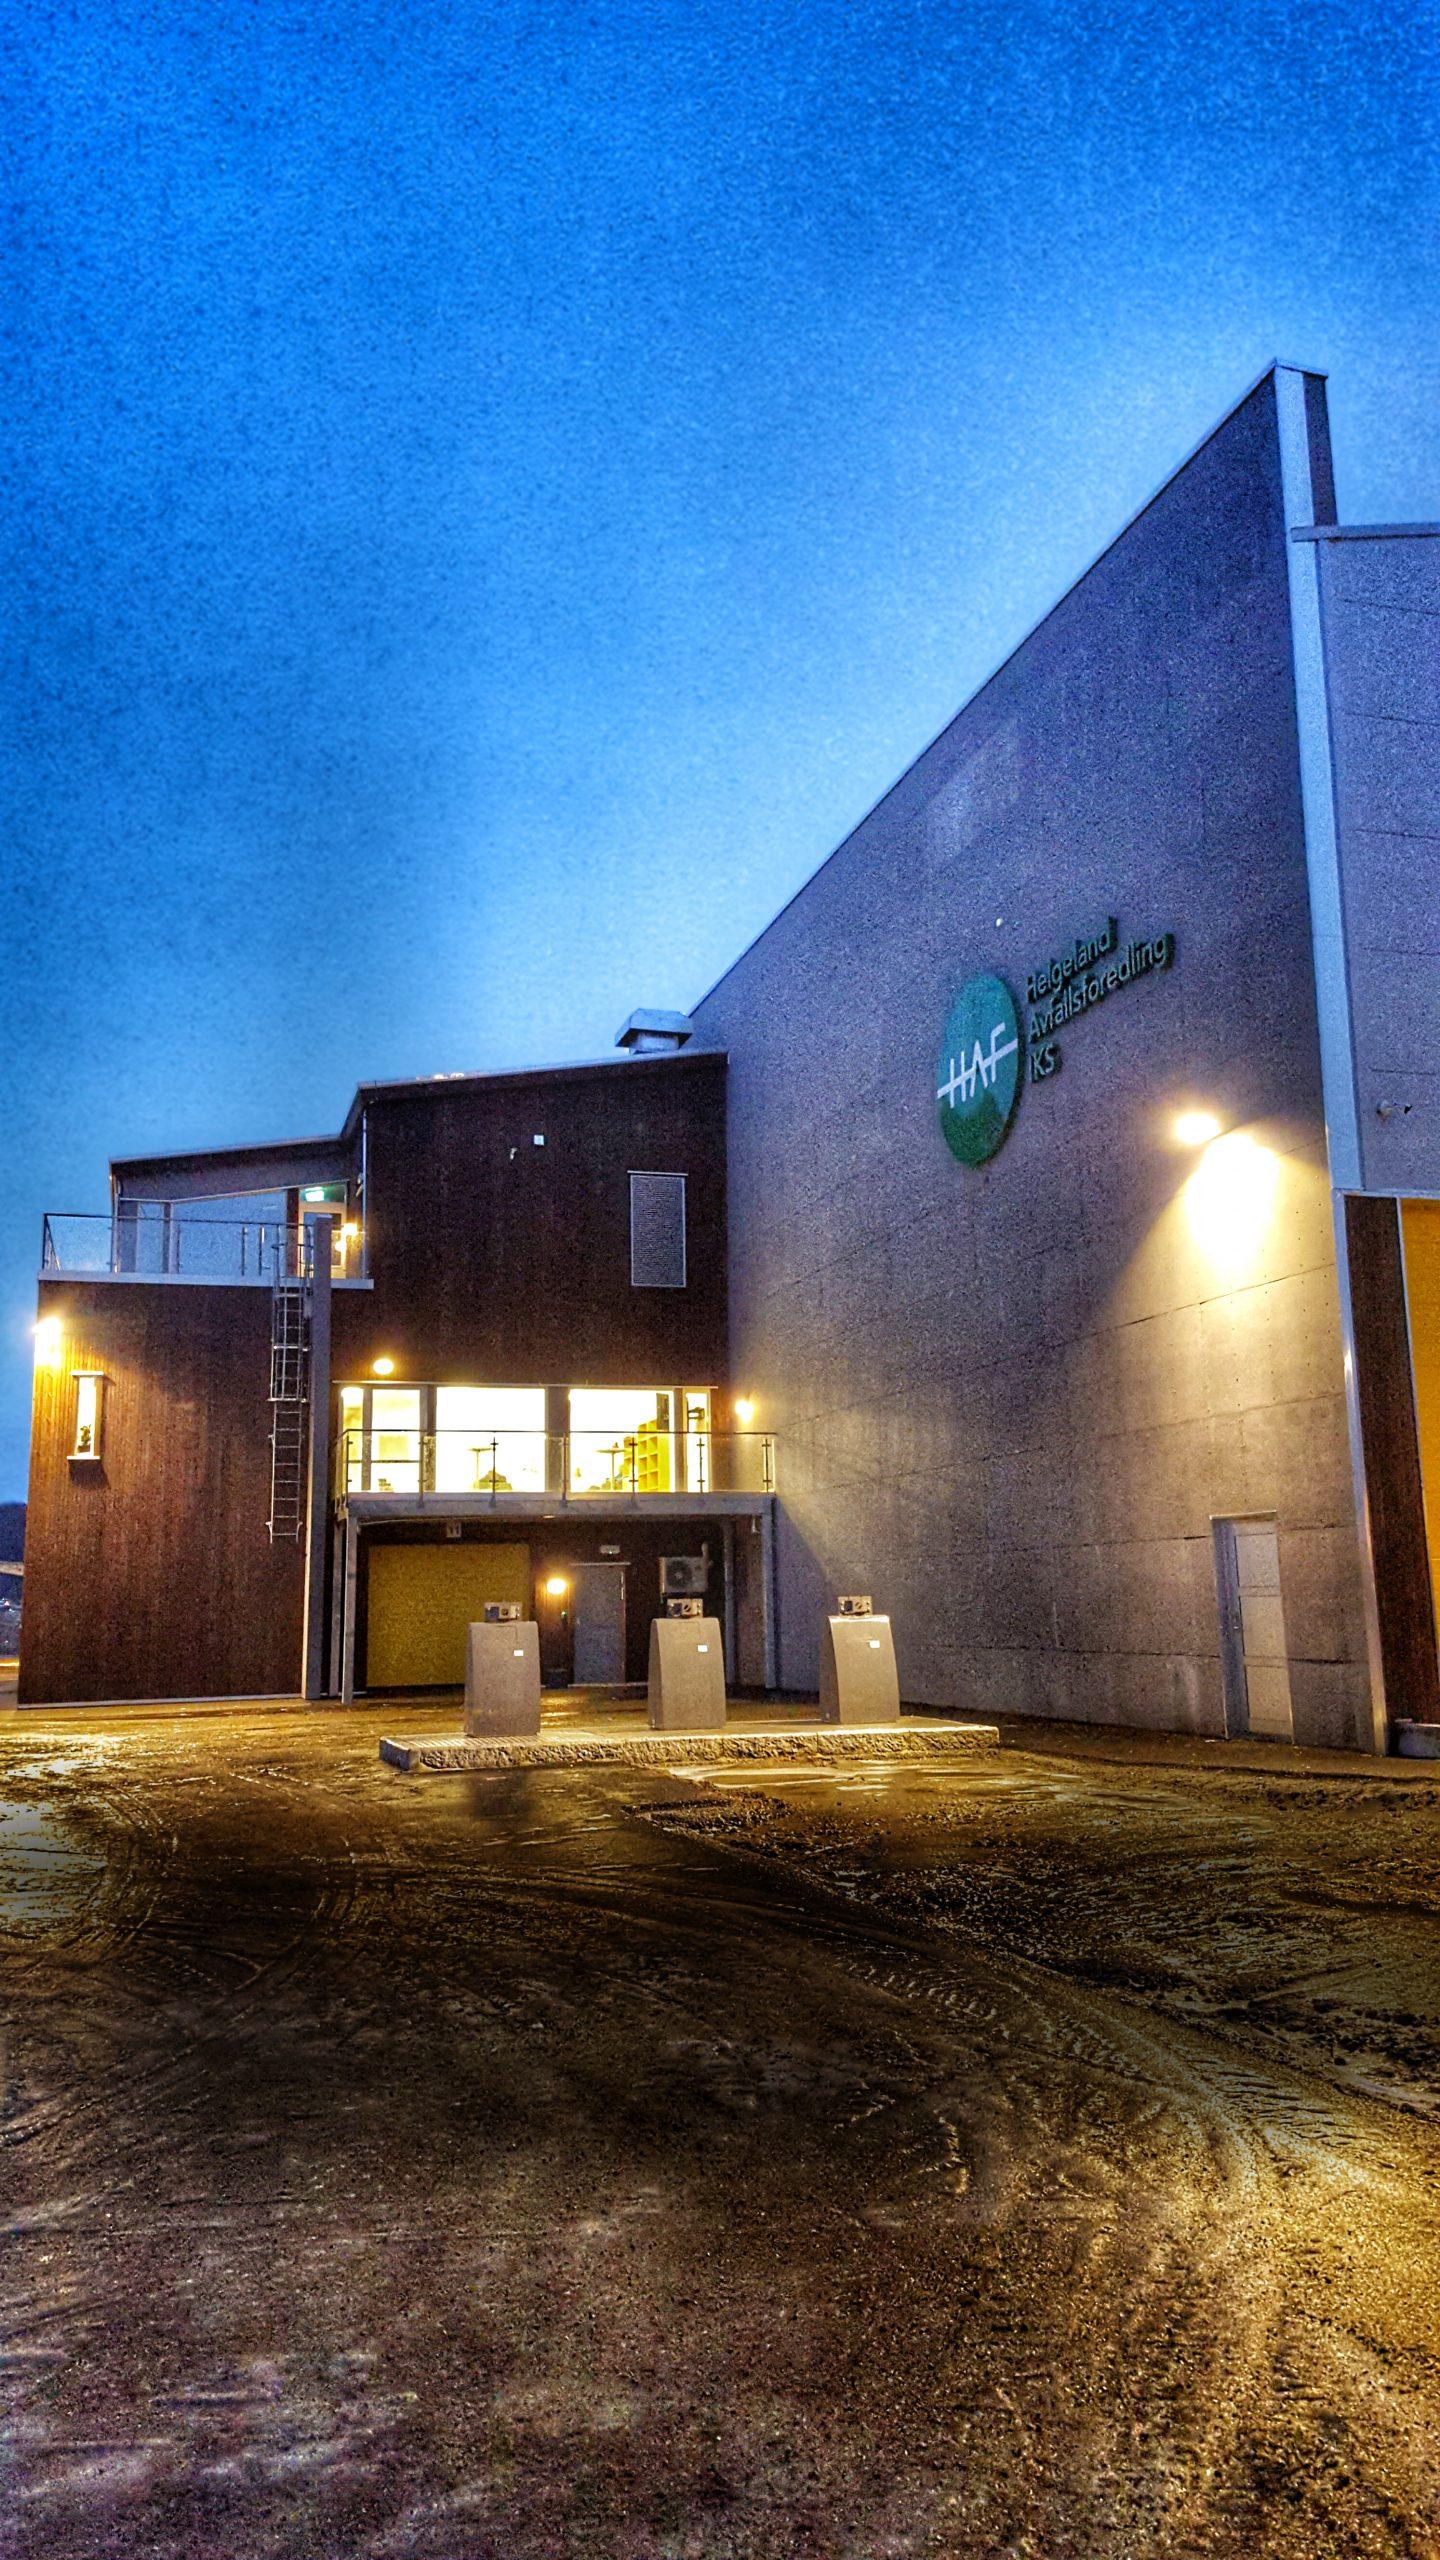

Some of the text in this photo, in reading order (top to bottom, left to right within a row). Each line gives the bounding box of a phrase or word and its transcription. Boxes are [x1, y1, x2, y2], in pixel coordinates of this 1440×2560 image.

[1026, 916, 1117, 1002] Helgeland
[1028, 933, 1173, 1043] Avfallsforedling
[937, 1022, 1018, 1108] HAF
